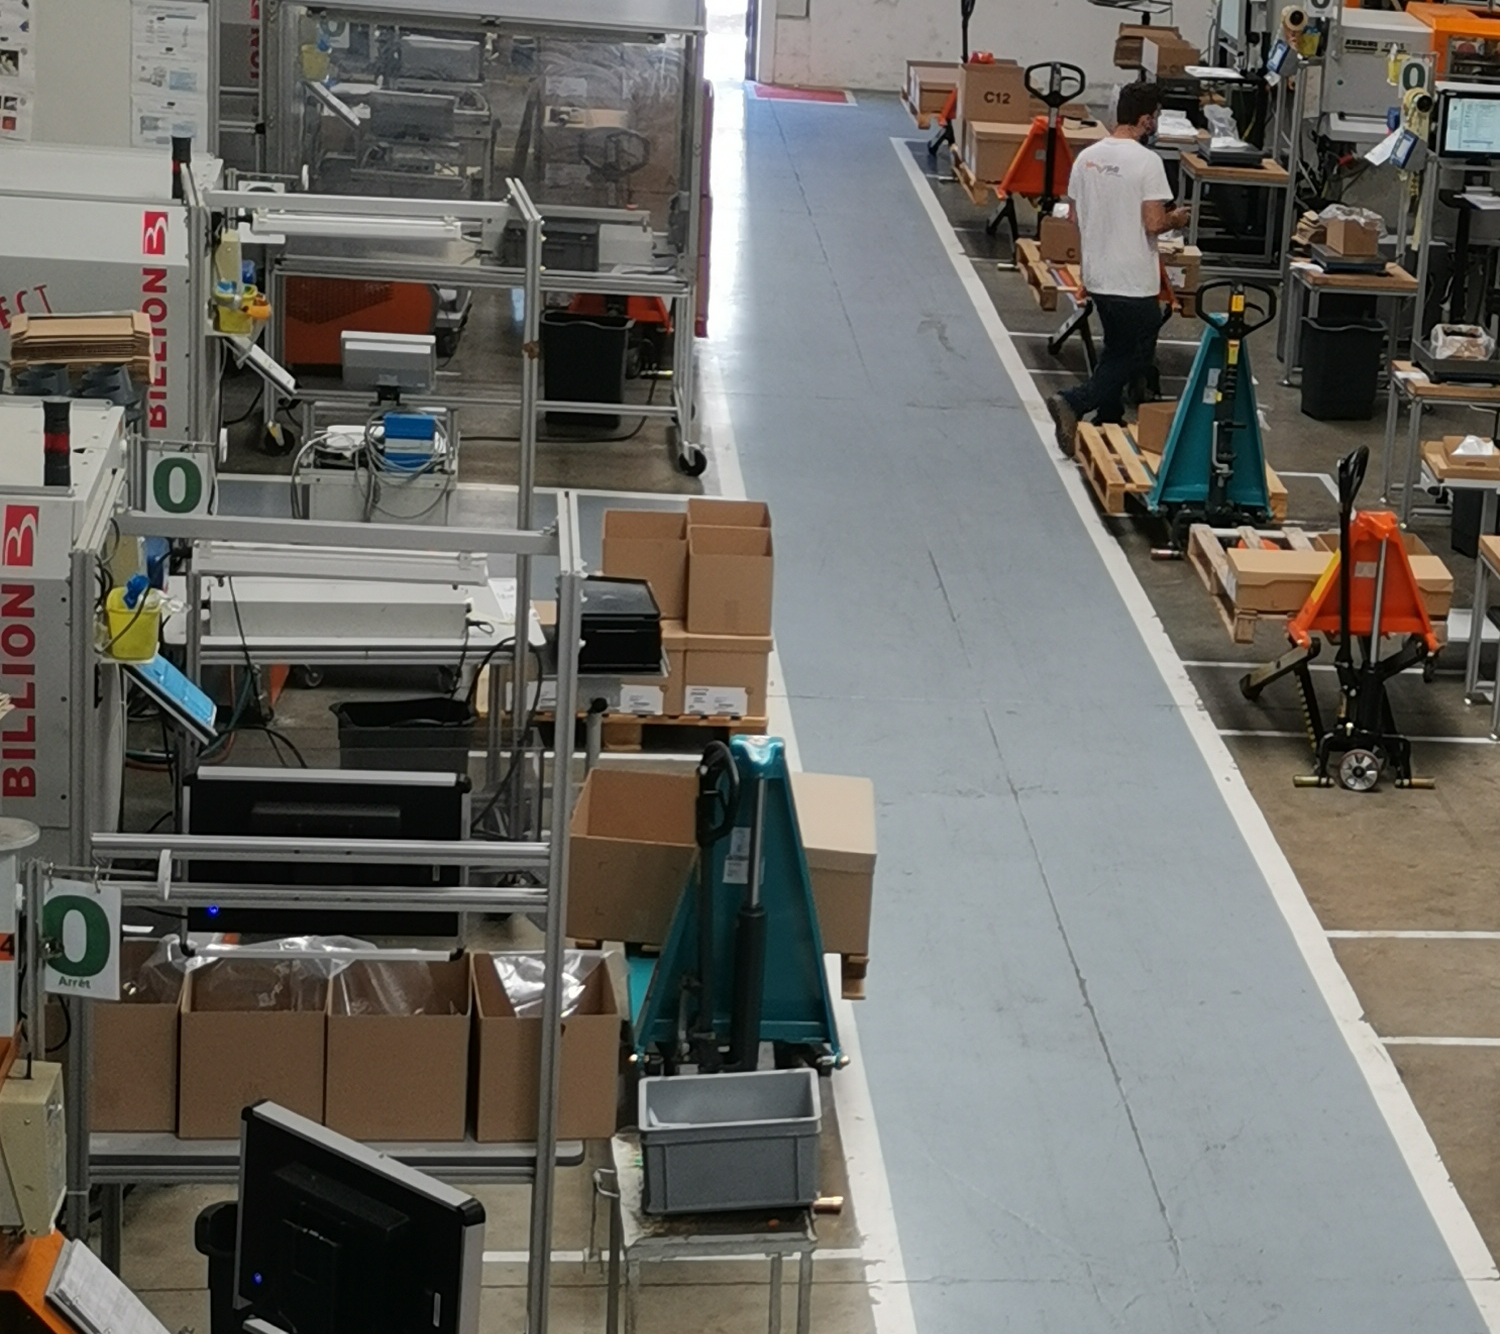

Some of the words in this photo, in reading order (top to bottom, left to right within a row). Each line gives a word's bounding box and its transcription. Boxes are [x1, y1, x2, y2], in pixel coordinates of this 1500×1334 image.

[984, 91, 1011, 104] C12
[153, 457, 201, 514] 0
[1, 584, 36, 798] BILLION
[43, 895, 111, 977] 0
